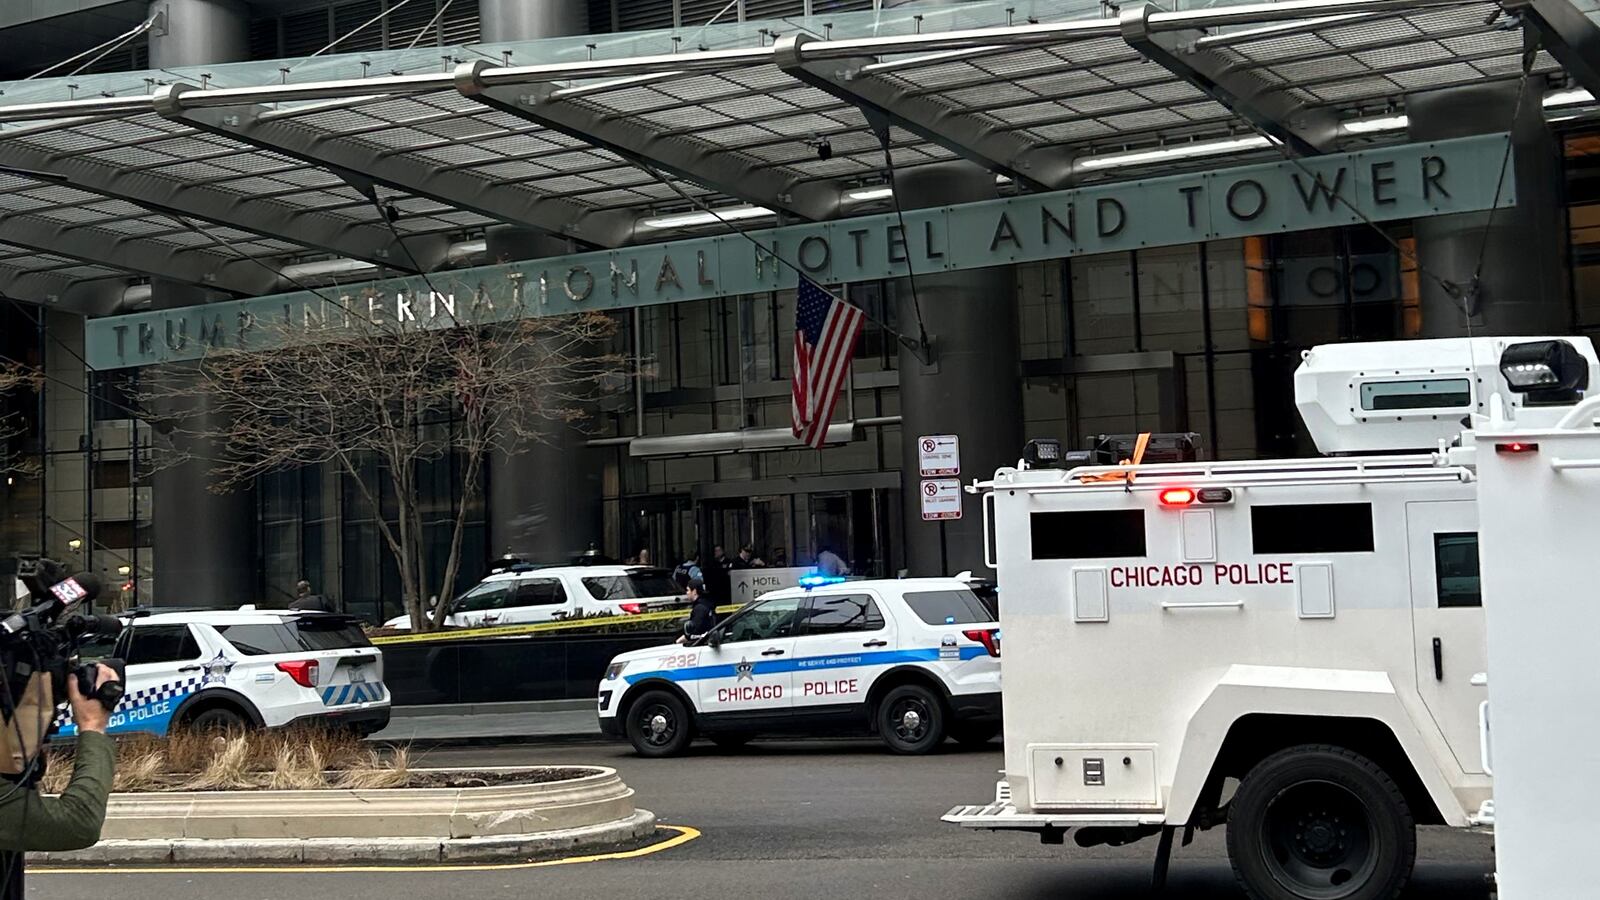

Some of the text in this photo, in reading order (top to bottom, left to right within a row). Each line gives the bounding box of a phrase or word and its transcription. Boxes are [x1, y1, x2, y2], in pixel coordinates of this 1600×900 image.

[113, 155, 1452, 358] TRUMP INTERNATIONAL HOTEL AND TOWER
[752, 577, 781, 586] HOTEL
[1110, 563, 1294, 588] CHICAGO POLICE
[657, 653, 698, 669] 7232
[717, 679, 858, 702] CHICAGO POLICE
[129, 701, 171, 722] POLICE
